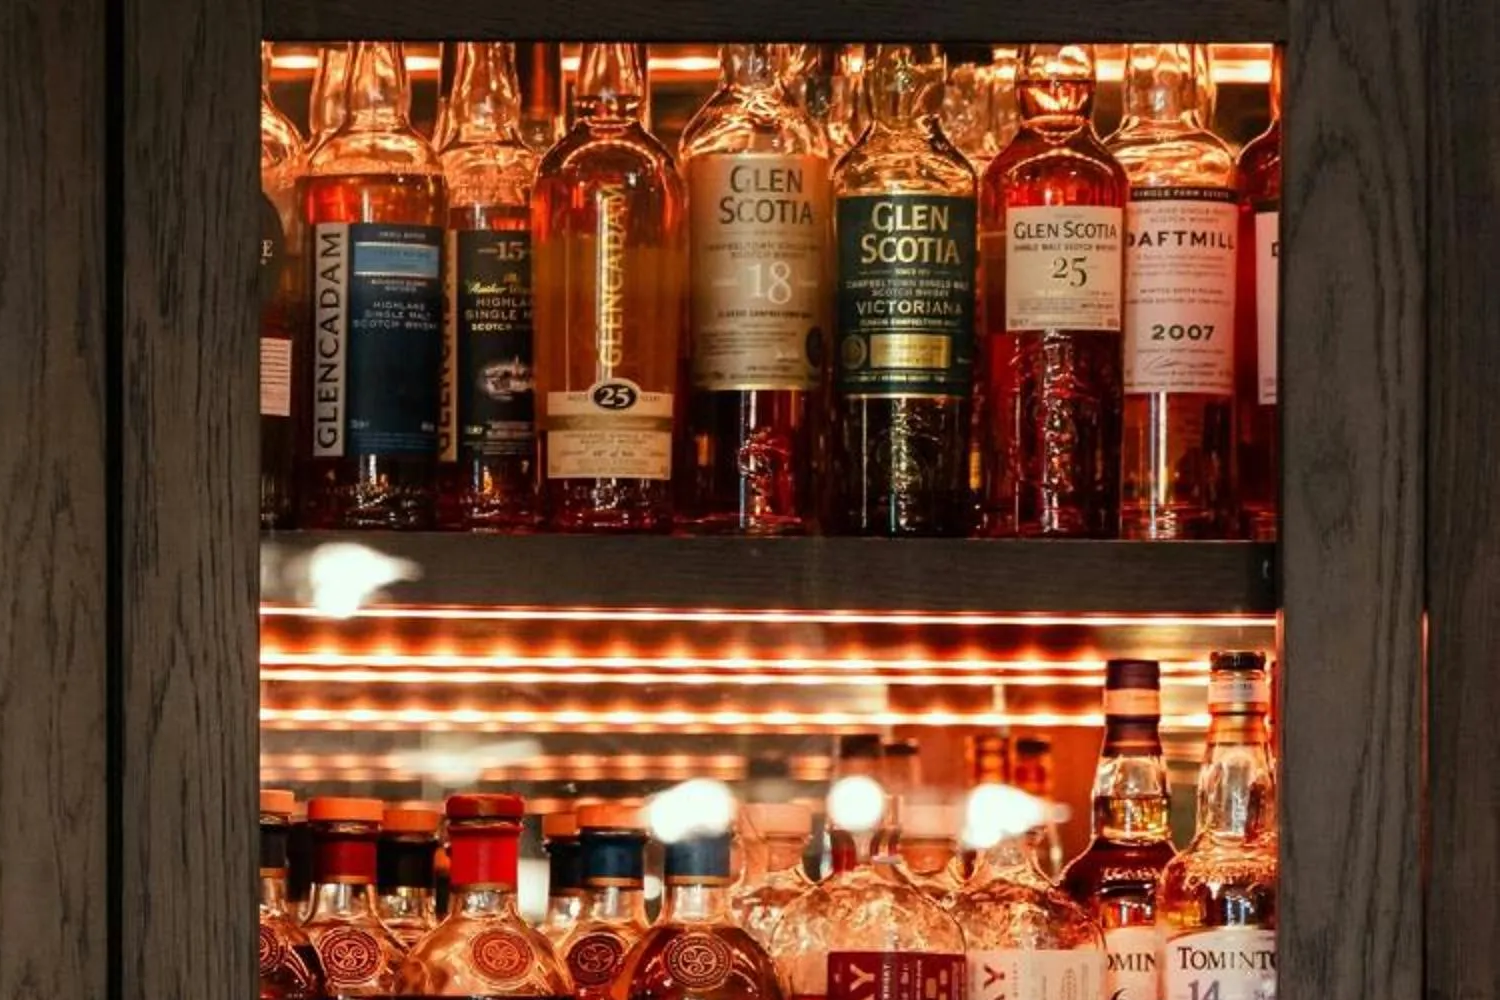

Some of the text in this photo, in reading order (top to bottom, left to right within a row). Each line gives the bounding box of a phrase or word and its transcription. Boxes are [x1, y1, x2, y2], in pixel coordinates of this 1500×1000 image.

[730, 165, 803, 193] GLEN
[719, 196, 814, 226] SCOTIA
[872, 201, 949, 232] GLEN
[1013, 220, 1118, 240] GLEN SCOTIA
[861, 233, 961, 264] SCOTIA
[600, 182, 626, 368] GLENCADAM
[747, 260, 792, 305] 18
[1051, 256, 1088, 288] 25
[855, 300, 963, 316] VICTORIANA
[317, 231, 342, 449] GLENCADAM
[1151, 324, 1216, 341] 2007
[600, 386, 631, 406] 25
